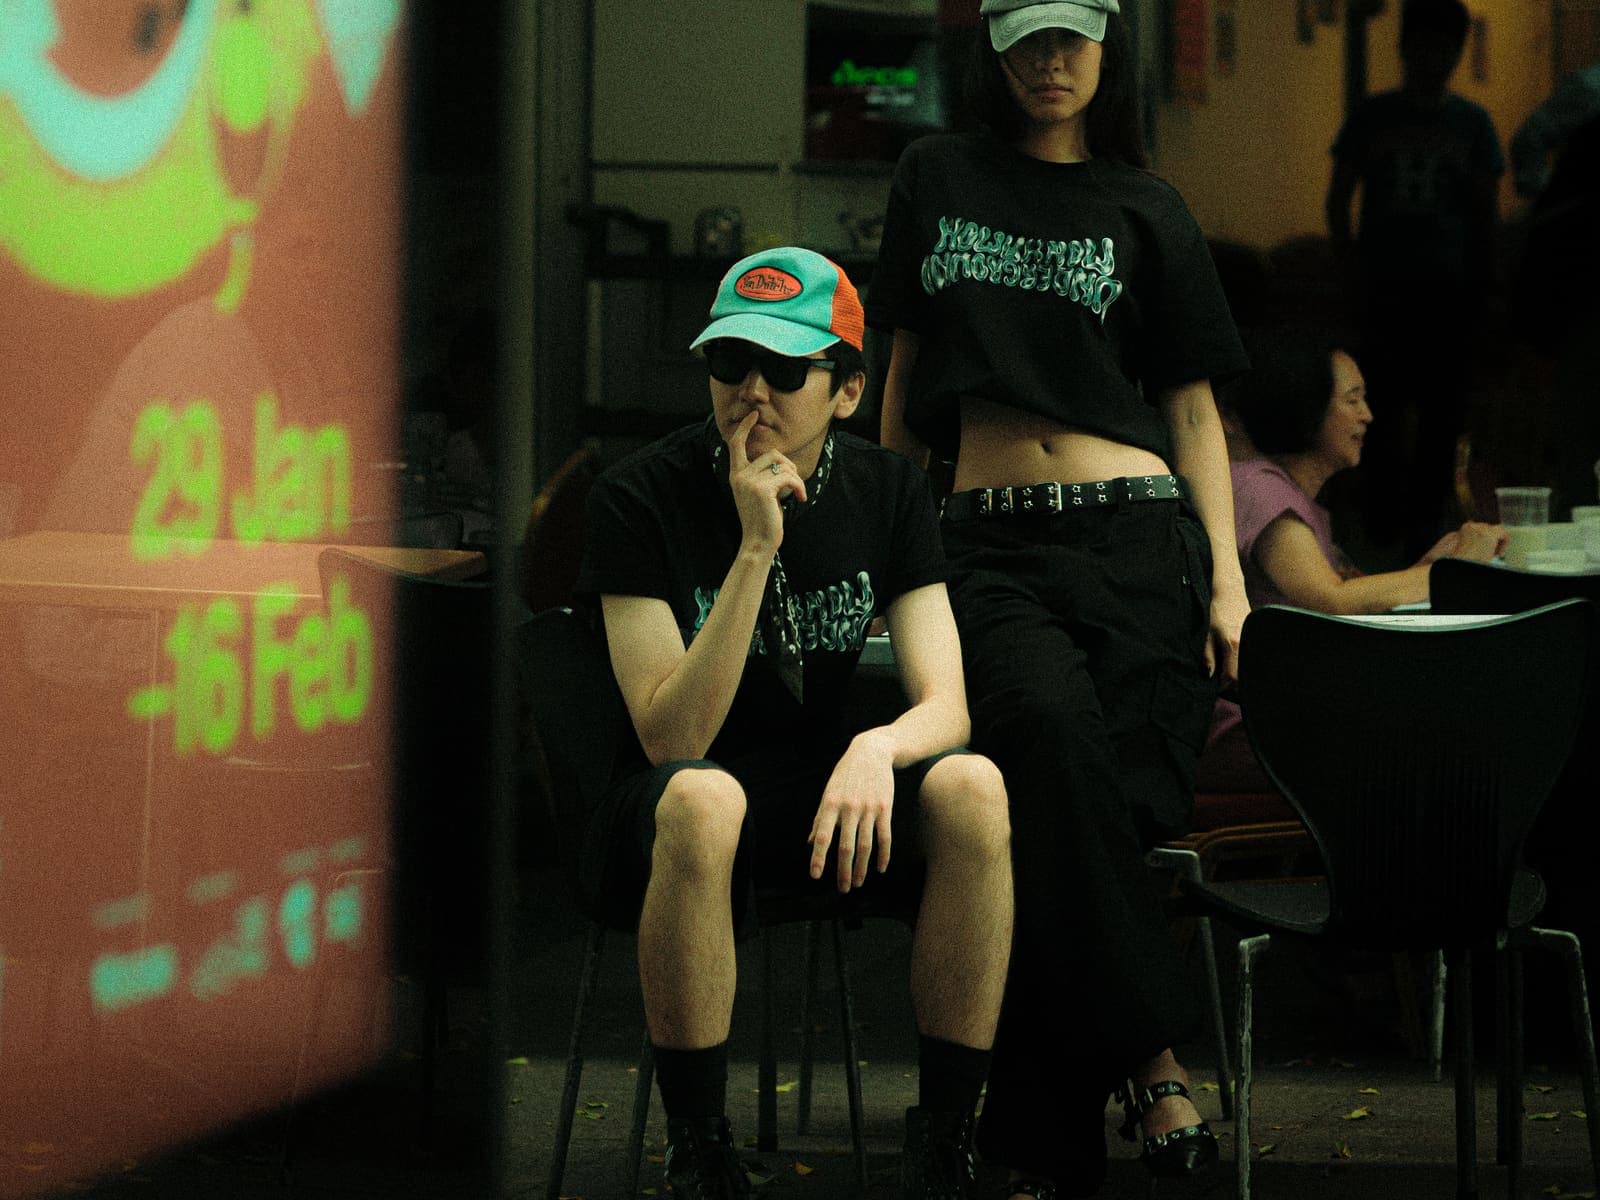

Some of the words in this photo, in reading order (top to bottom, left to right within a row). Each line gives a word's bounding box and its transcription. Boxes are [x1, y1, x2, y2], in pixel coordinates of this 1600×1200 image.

[131, 399, 223, 561] 29
[232, 393, 352, 545] Jan
[250, 579, 373, 740] Feb
